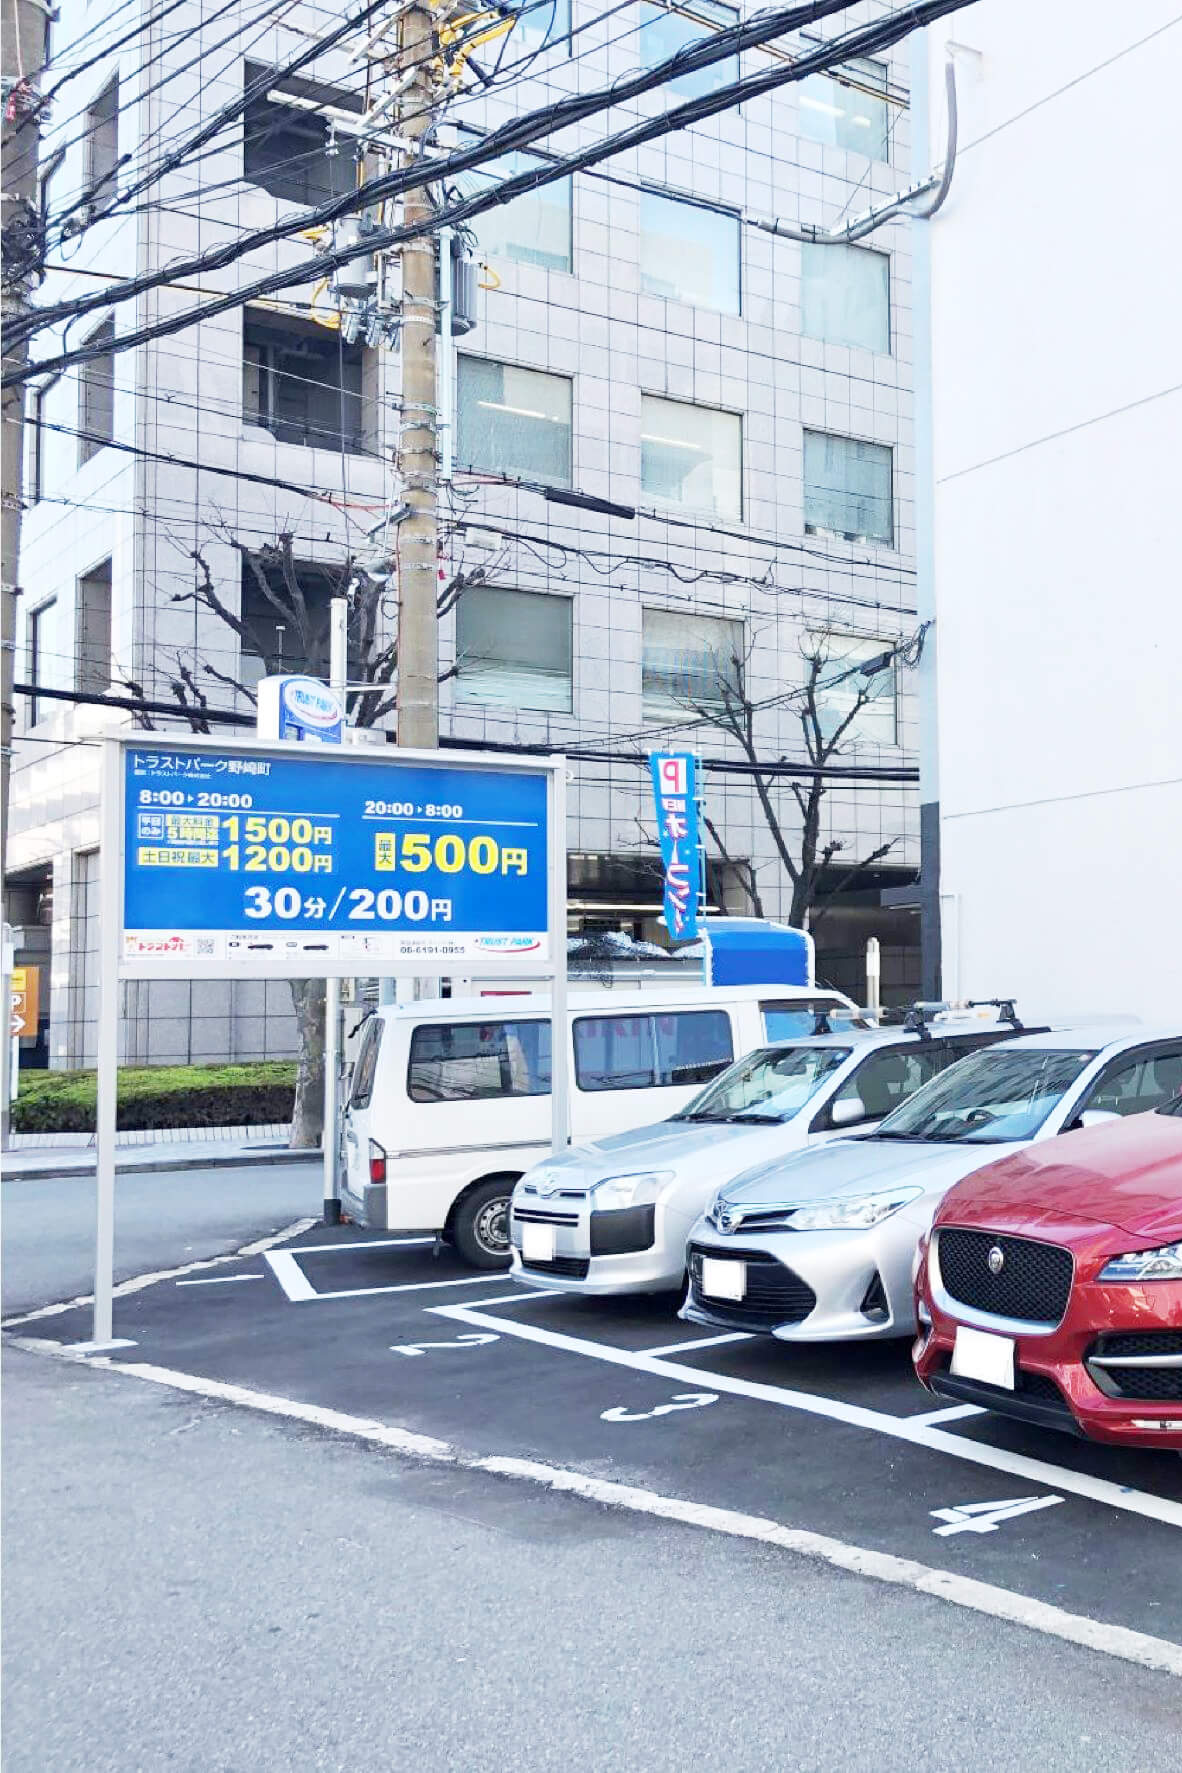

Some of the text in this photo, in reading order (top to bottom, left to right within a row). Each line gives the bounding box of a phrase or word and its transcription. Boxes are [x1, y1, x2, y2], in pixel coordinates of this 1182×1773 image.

[139, 789, 253, 808] 8:00 20:00
[365, 800, 463, 818] 20:00 8:00
[222, 815, 332, 845] 1500円
[222, 845, 332, 873] 1200円
[400, 833, 528, 876] 500円
[389, 1333, 500, 1357] 2
[600, 1393, 719, 1423] 3
[928, 1494, 1066, 1538] 4
